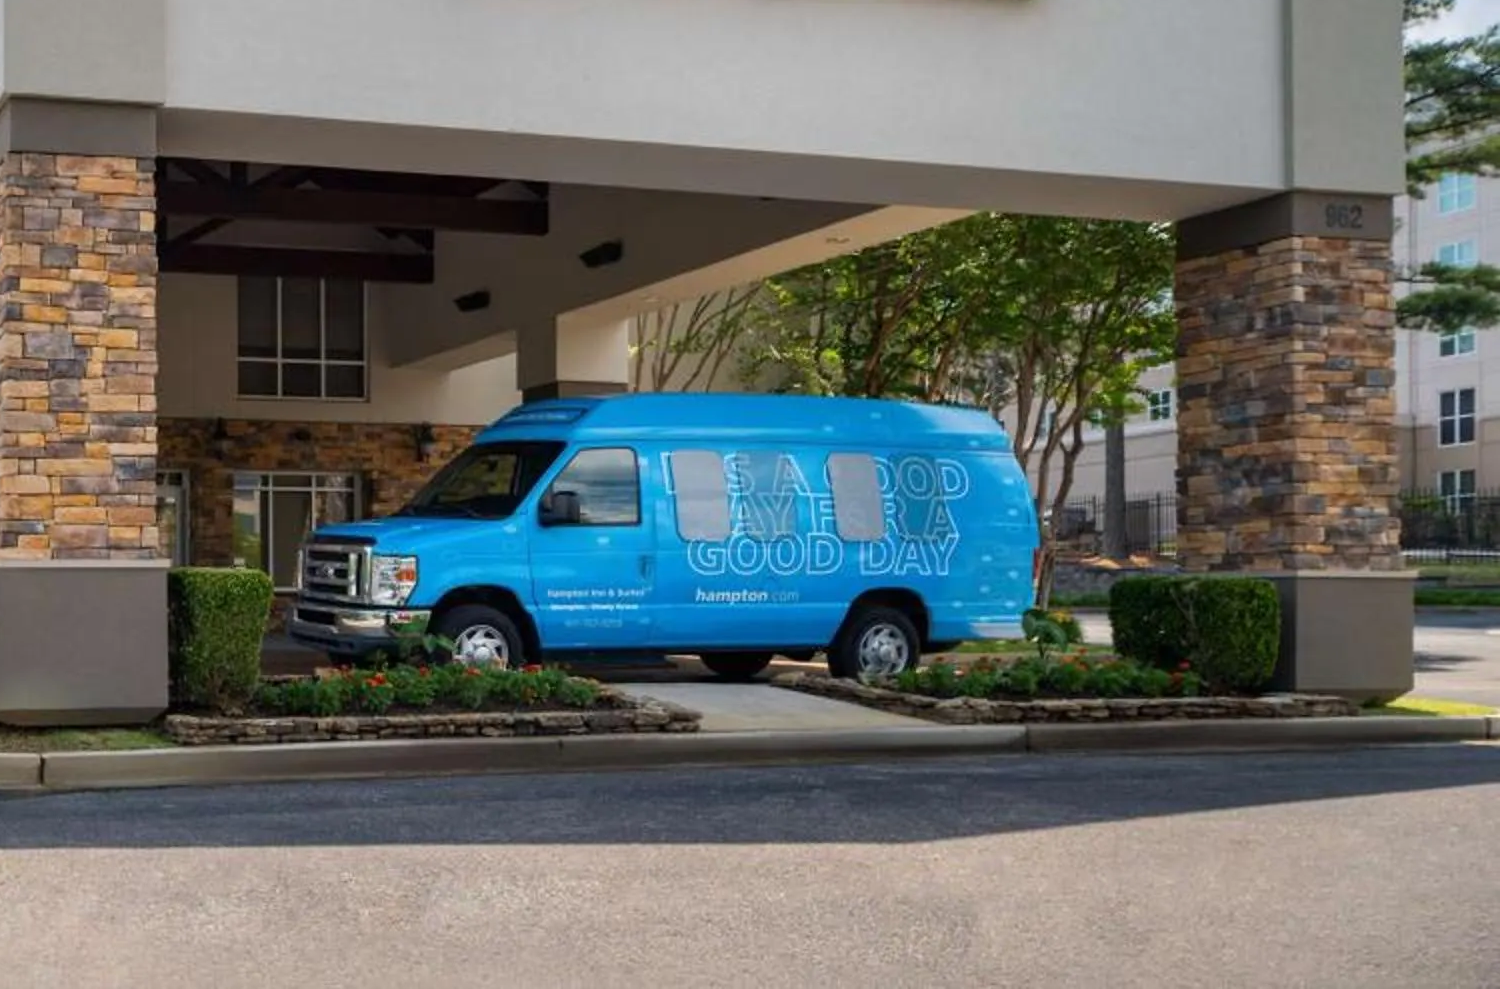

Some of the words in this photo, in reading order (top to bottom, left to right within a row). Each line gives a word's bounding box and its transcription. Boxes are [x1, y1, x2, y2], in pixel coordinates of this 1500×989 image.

[1325, 203, 1363, 229] 962
[773, 454, 811, 496] A
[823, 456, 970, 500] OOD
[730, 493, 795, 535] AY
[809, 492, 910, 537] FR
[923, 496, 960, 539] A
[687, 531, 843, 576] GOOD
[860, 534, 960, 576] DAY
